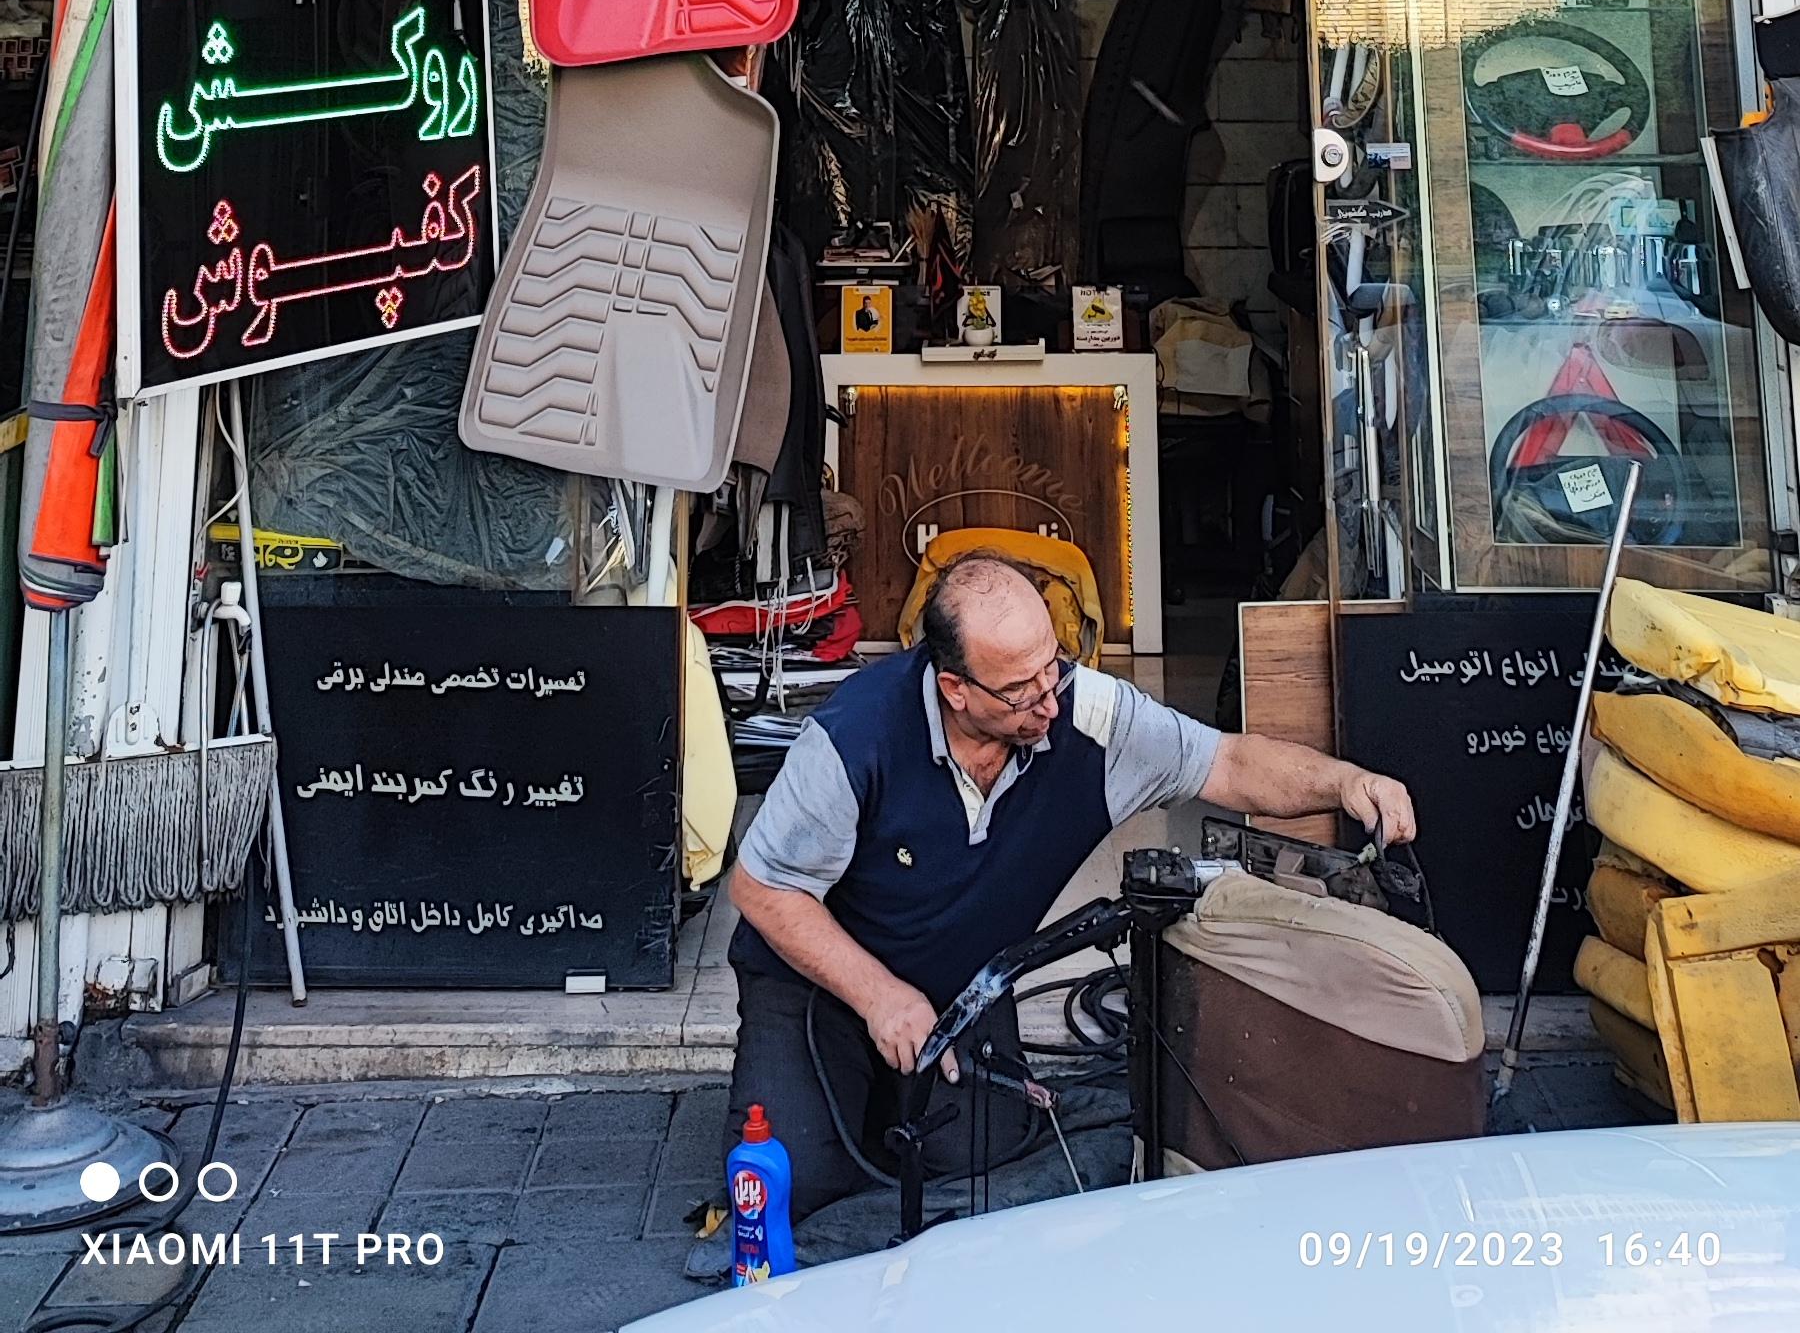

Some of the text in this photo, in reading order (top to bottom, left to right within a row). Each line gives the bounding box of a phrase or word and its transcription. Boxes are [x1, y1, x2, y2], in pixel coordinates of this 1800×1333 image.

[157, 7, 478, 172] روکش
[162, 165, 480, 358] کفپوش
[878, 432, 1085, 520] Welcome
[317, 661, 586, 697] تعمیرات تخصصی صندلی برقی
[1400, 651, 1492, 683] اتومبیل
[1501, 650, 1559, 685] انواع
[1466, 724, 1526, 754] خودرو
[297, 765, 363, 798] ایمنی
[371, 769, 453, 804] کمربند
[523, 775, 584, 807] تغییر
[368, 901, 407, 932] اتاق
[410, 901, 460, 932] داخل
[467, 903, 513, 934] کامل
